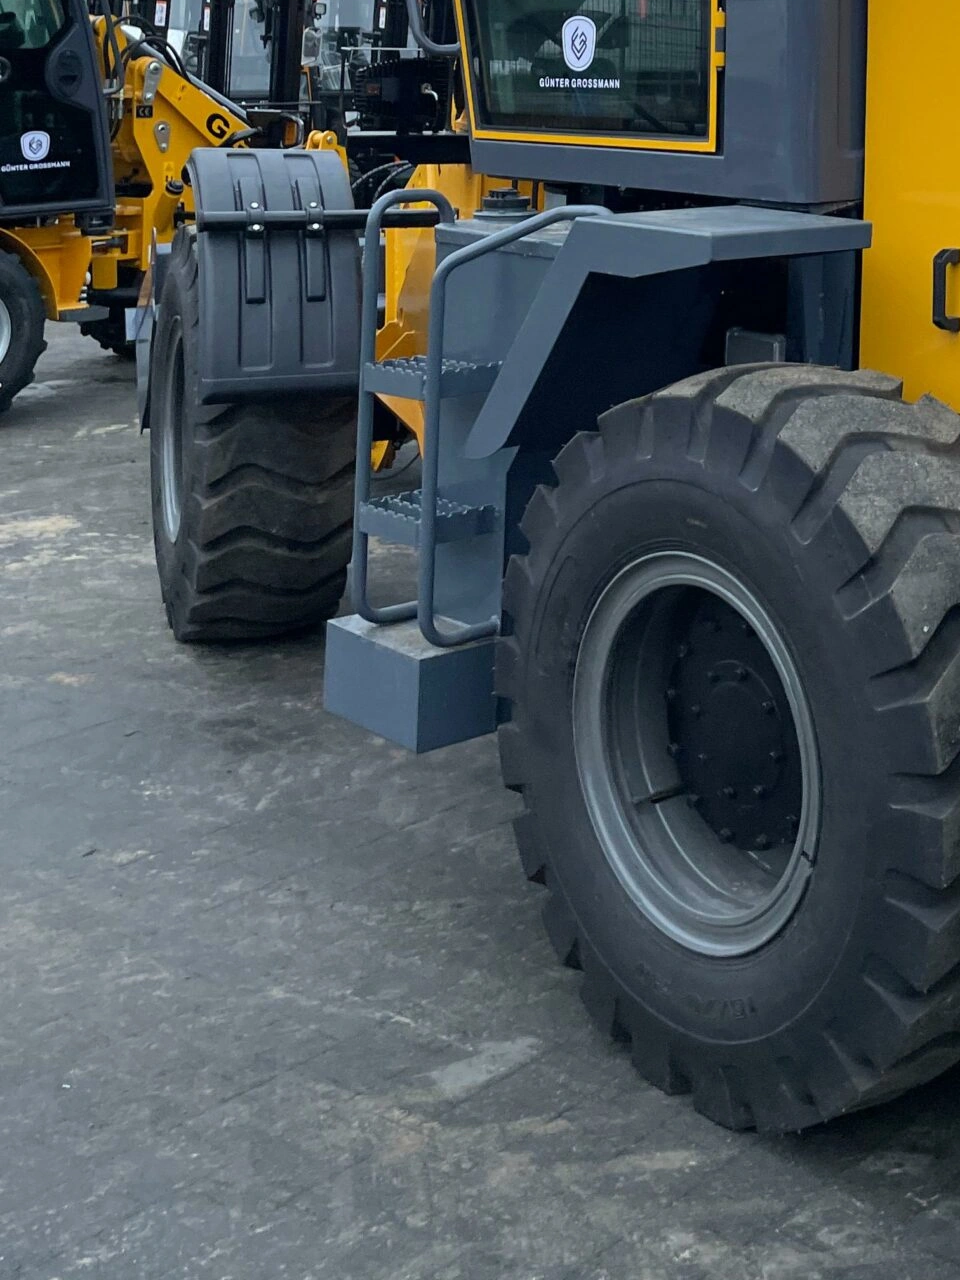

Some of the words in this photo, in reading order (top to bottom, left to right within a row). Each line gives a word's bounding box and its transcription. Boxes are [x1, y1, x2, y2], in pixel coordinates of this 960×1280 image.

[539, 76, 570, 88] GÜNTER
[571, 78, 620, 89] GROSSMANN
[1, 163, 28, 173] GÜNTER
[29, 160, 70, 170] GROSSMANN
